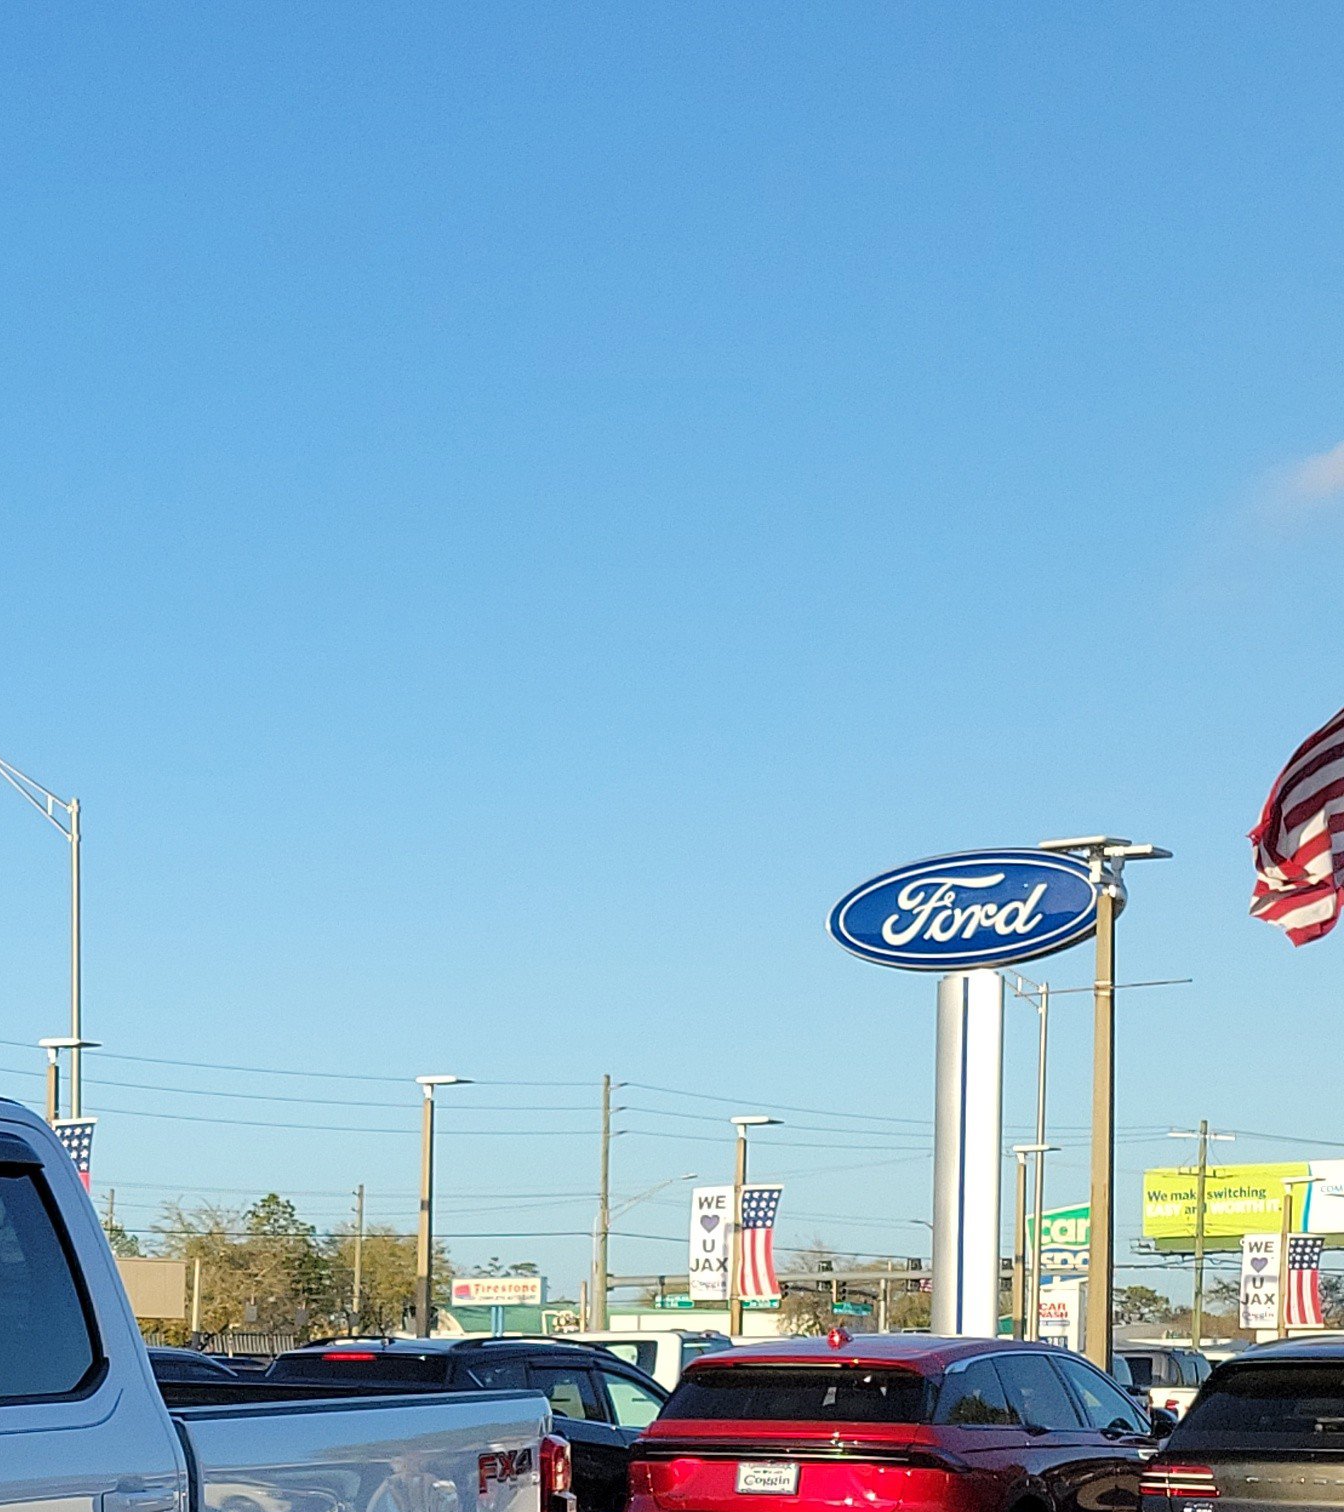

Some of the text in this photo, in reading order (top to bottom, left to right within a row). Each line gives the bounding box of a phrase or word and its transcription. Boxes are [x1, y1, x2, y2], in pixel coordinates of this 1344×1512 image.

[882, 872, 1048, 946] Ford
[1147, 1186, 1267, 1203] We mak switching
[698, 1195, 727, 1210] WE
[702, 1239, 716, 1253] U
[1249, 1241, 1275, 1253] WE
[690, 1257, 729, 1273] JAX
[474, 1283, 538, 1296] Firestone
[1252, 1276, 1265, 1289] U
[1240, 1293, 1276, 1306] JAX
[478, 1449, 533, 1494] FX4
[744, 1474, 791, 1486] Coggin
